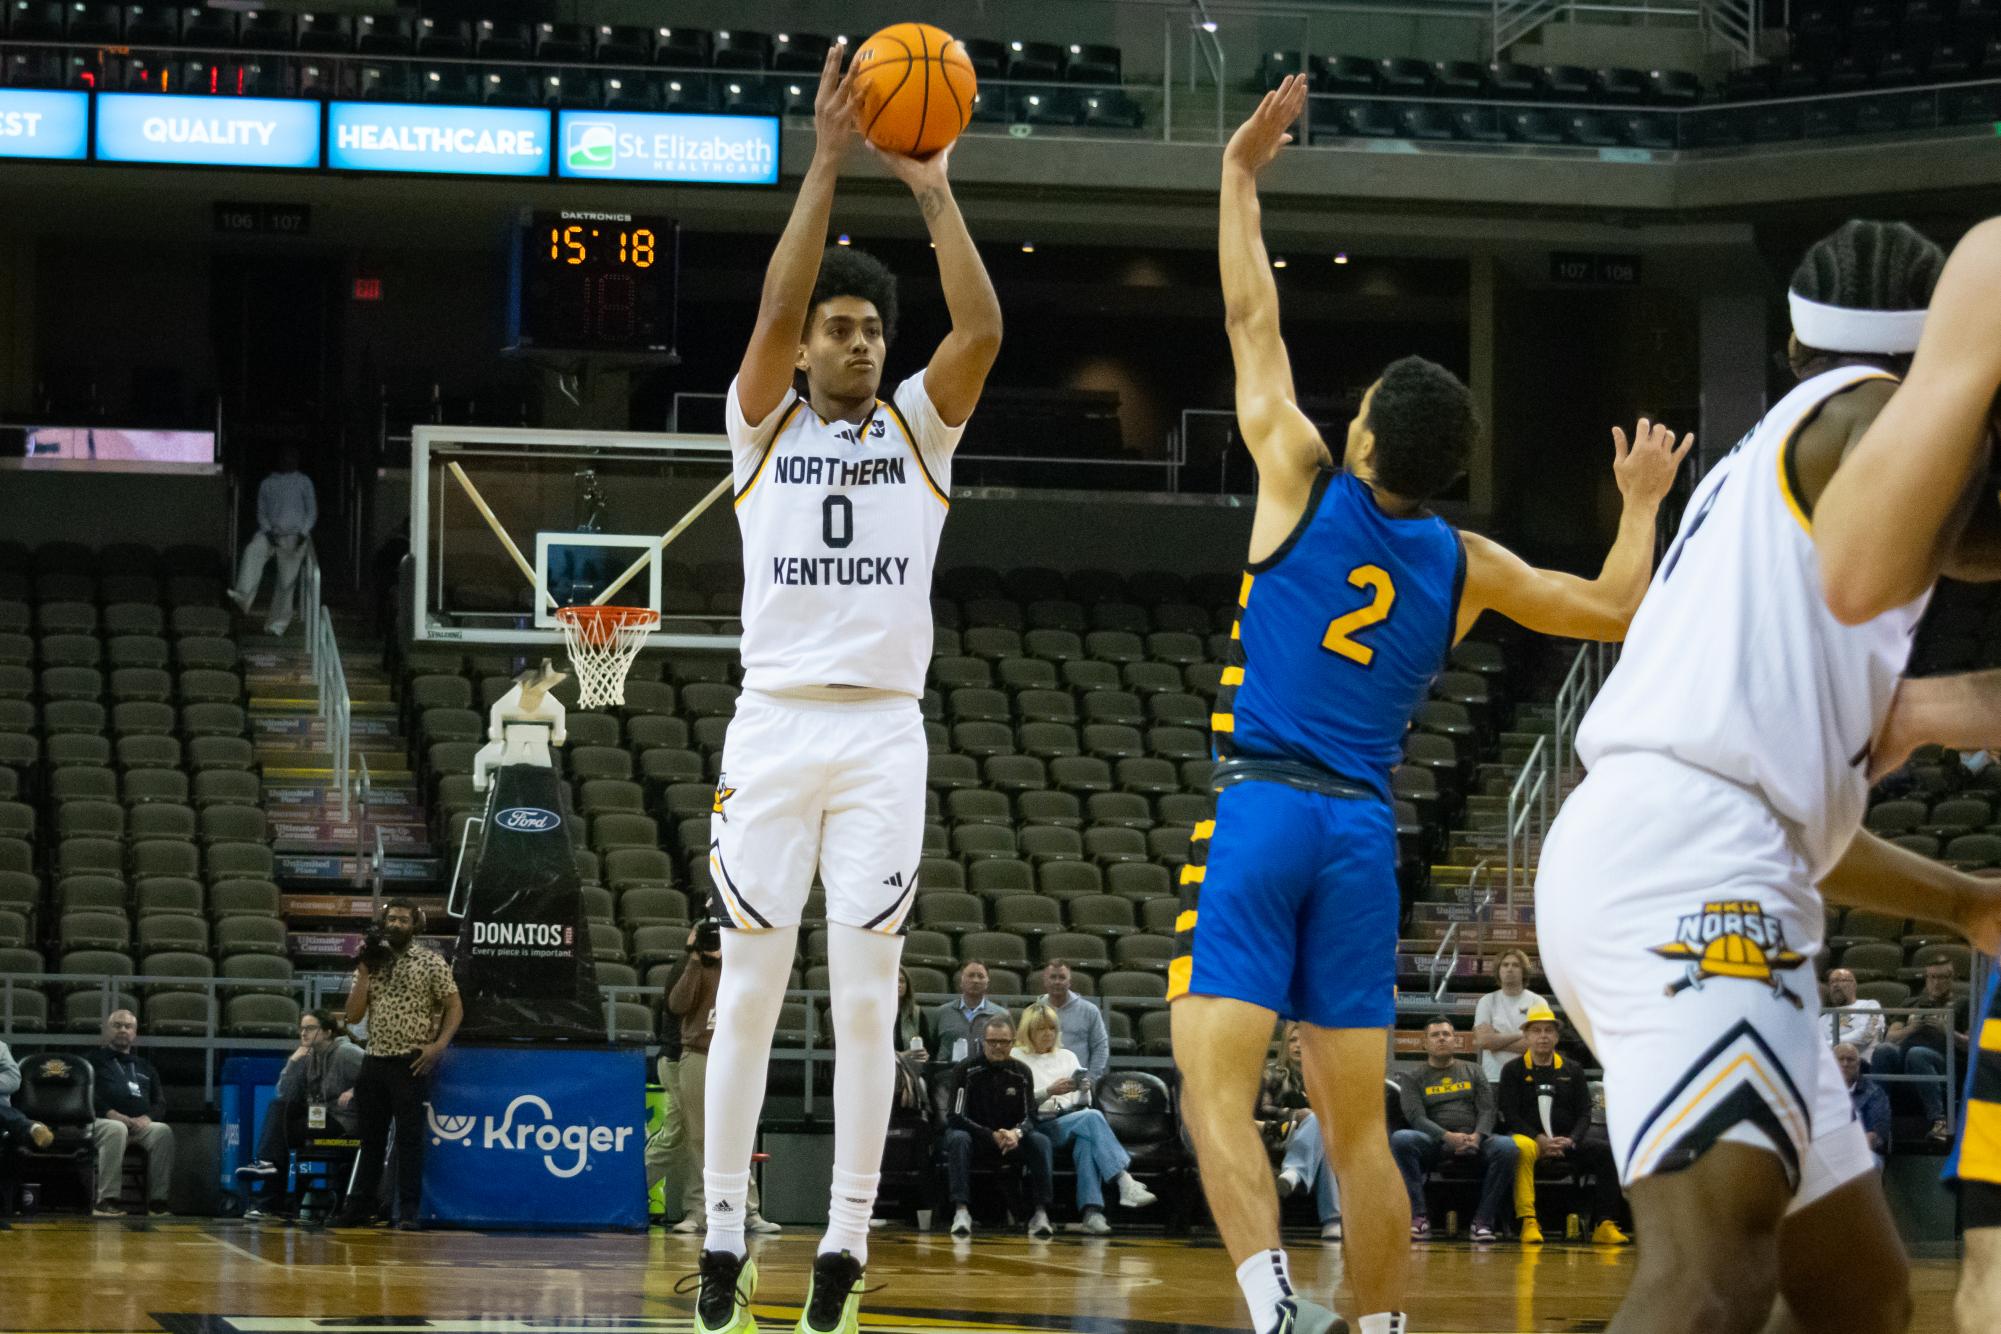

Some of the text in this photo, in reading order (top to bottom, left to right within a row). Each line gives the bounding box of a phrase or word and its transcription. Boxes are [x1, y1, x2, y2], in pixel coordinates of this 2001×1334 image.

[142, 117, 276, 146] QUALITY
[338, 125, 543, 156] HEALTHCARE.
[654, 134, 771, 162] Elizabeth
[653, 161, 771, 175] HEALTHCARE
[560, 211, 632, 222] DAKTRONICS
[774, 455, 906, 486] NORTHERN
[822, 494, 853, 549] 0
[773, 556, 909, 586] KENTUCKY
[1320, 562, 1397, 668] 2
[507, 810, 548, 829] Ford
[1704, 902, 1761, 914] NKU
[472, 921, 562, 946] DONATOS
[1677, 913, 1785, 953] NORSE
[472, 946, 495, 957] Every
[497, 948, 519, 956] piece
[521, 947, 529, 956] is
[1431, 1081, 1464, 1095] NKU
[484, 1094, 633, 1178] Kroger
